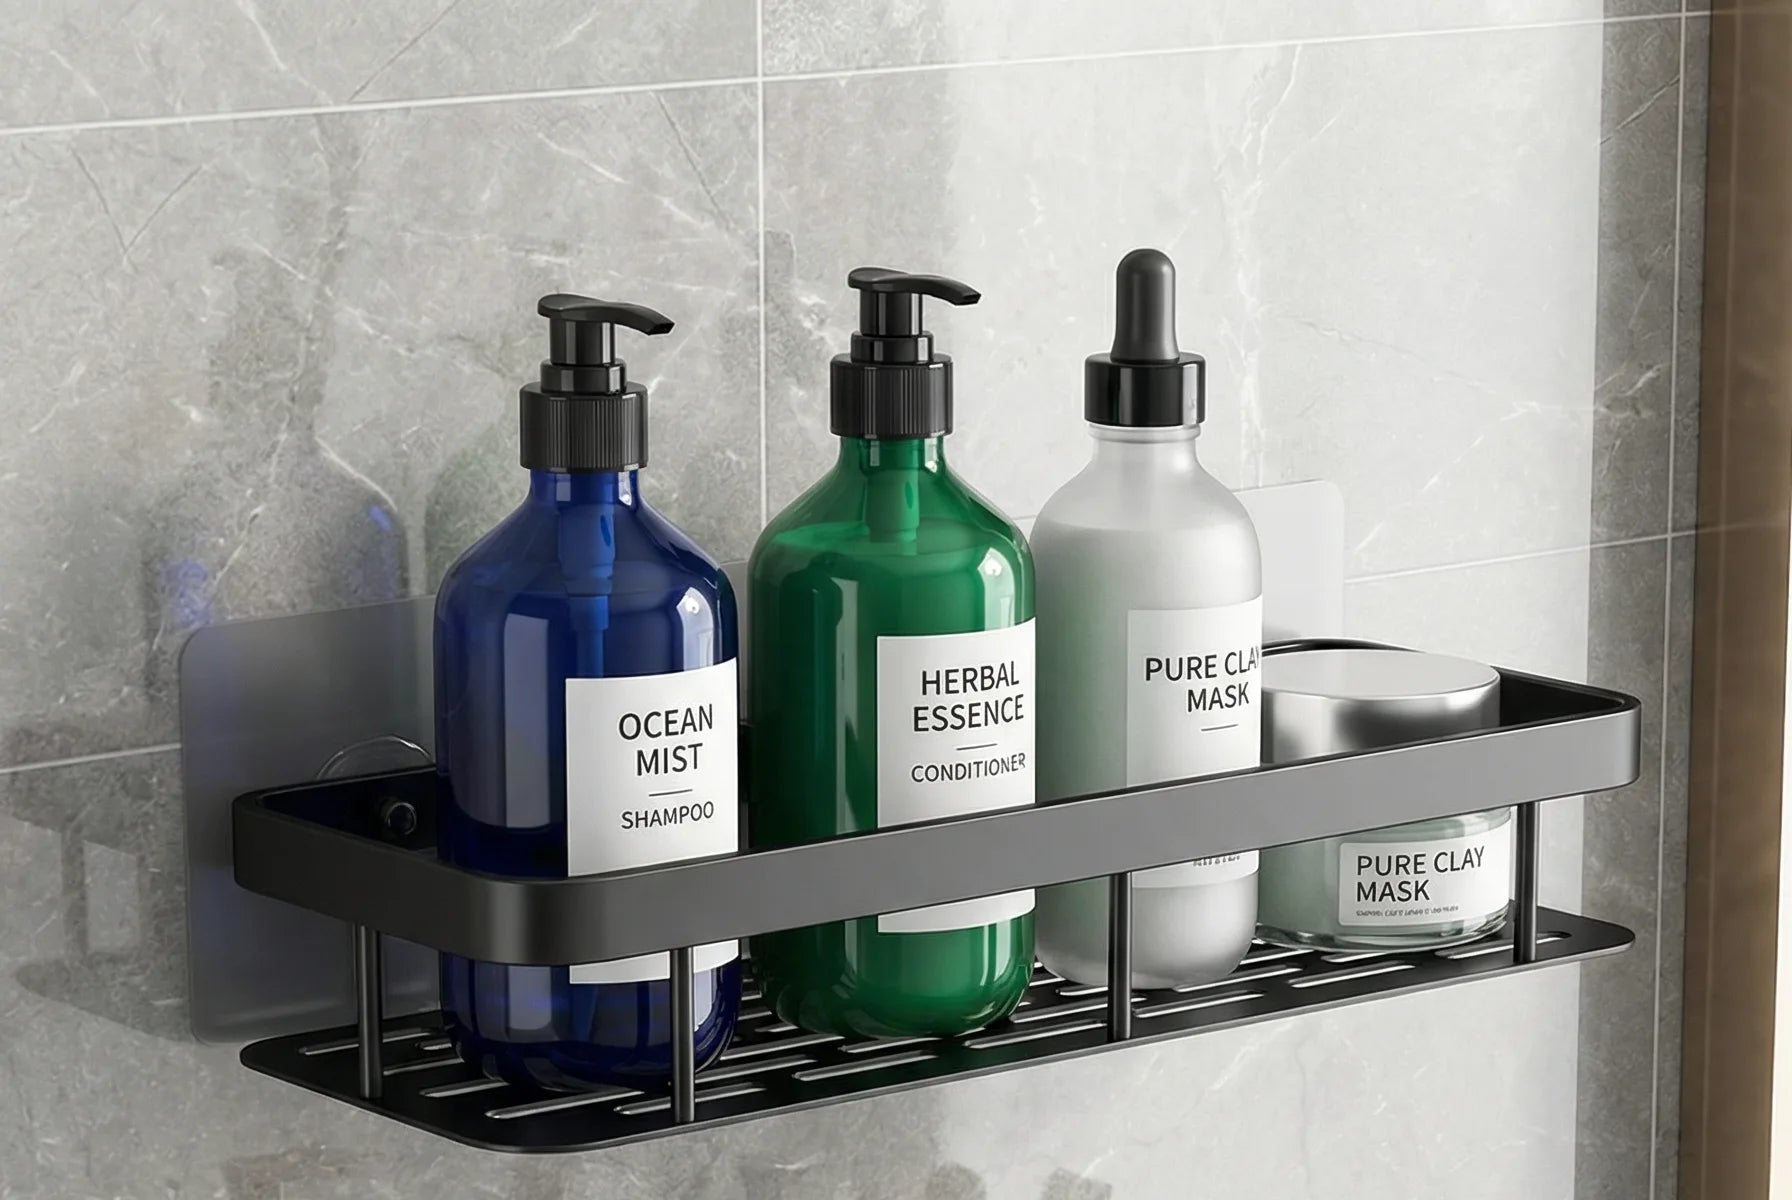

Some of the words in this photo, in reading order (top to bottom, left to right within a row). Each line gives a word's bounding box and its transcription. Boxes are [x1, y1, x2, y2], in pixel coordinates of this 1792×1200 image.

[922, 660, 1019, 695] HERBAL
[1145, 654, 1217, 681] PURE
[1187, 682, 1249, 712] MASK
[618, 703, 713, 740] OCEAN
[913, 694, 1024, 732] ESSENCE
[636, 743, 703, 776] MIST
[911, 752, 1026, 782] CONDITIONER
[621, 801, 714, 829] SHAMPOO
[1357, 853, 1426, 876] PURE
[1433, 845, 1485, 873] CLAY
[1356, 879, 1430, 902] MASK
